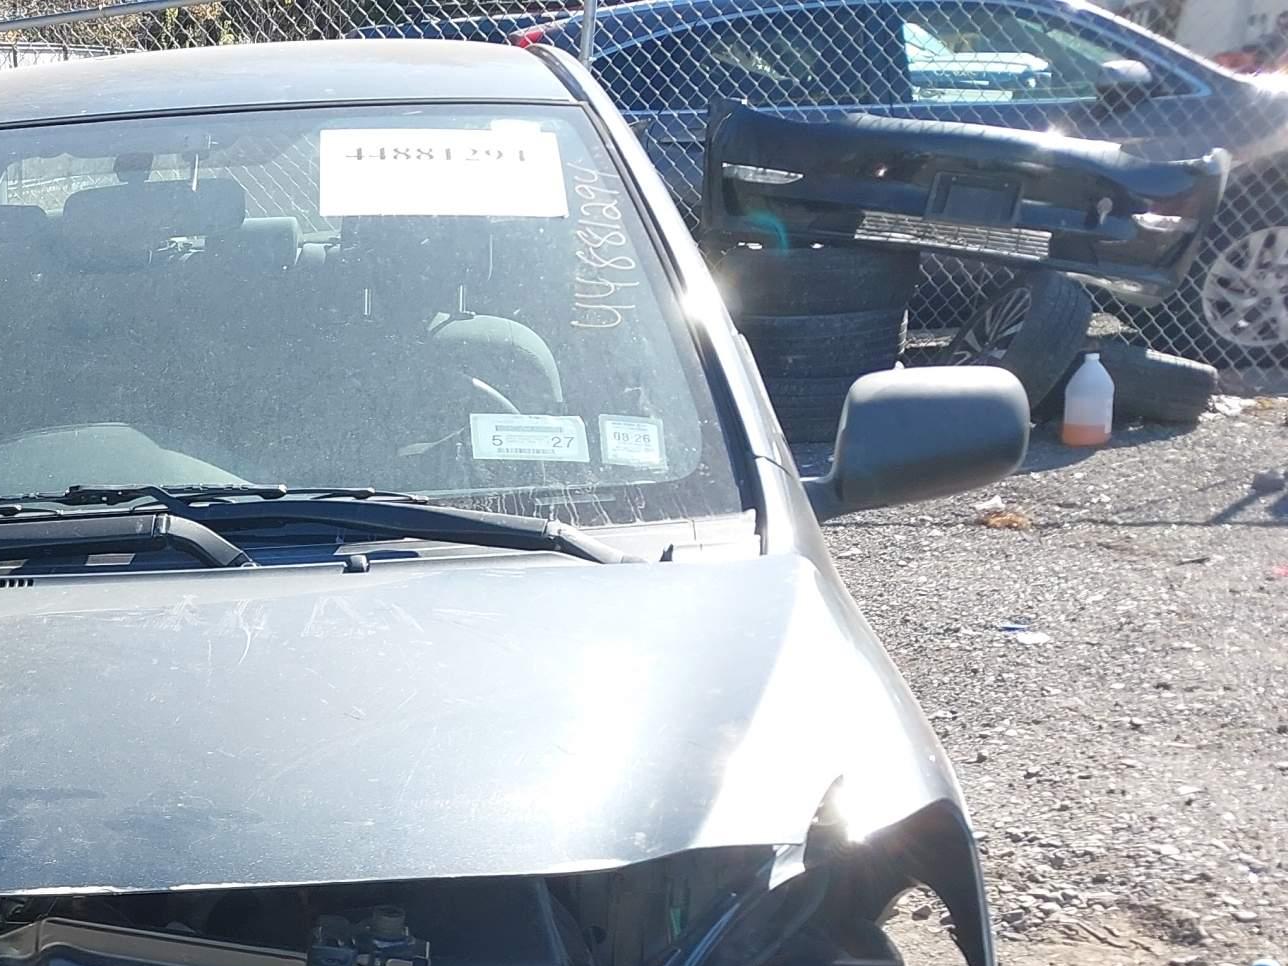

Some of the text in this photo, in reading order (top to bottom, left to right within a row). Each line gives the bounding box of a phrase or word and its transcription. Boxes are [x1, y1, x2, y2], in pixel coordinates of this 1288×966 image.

[567, 162, 640, 328] 44881294
[491, 434, 504, 447] 5
[550, 435, 575, 449] 27
